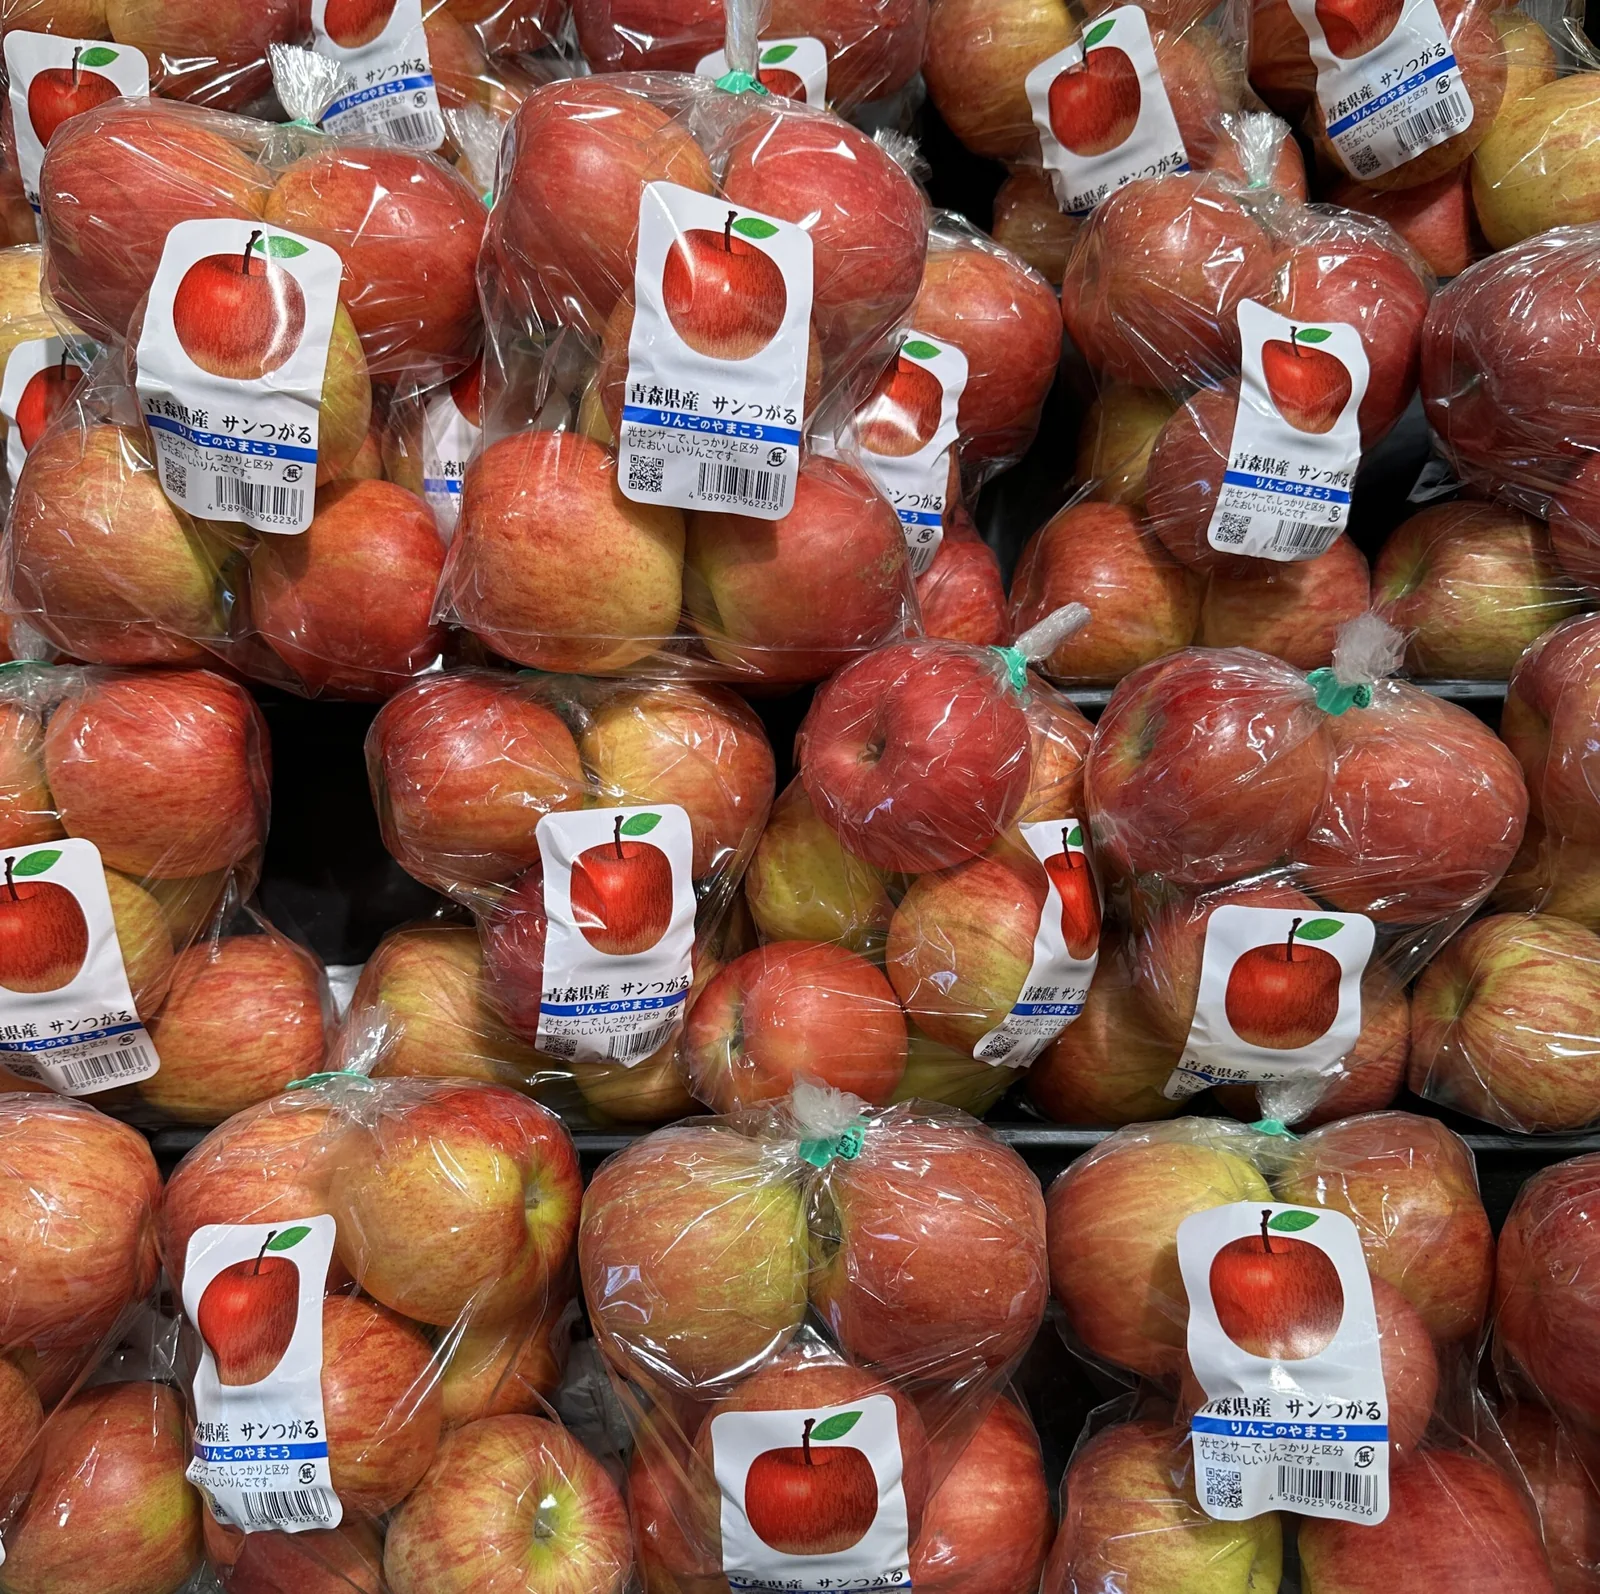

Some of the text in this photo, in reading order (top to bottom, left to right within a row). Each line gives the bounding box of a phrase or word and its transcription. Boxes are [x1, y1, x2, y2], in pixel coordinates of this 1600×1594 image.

[365, 58, 425, 84] サンつがる
[1327, 43, 1446, 123] 青森県産 サンつがる
[339, 81, 405, 110] りんごのやまこう
[1352, 74, 1427, 122] りんごのやまこう
[631, 383, 798, 425] 青森県産 サンつがる
[222, 415, 312, 444] サンつがる
[660, 412, 764, 439] りんごのやまこう
[179, 425, 278, 456] りんごのやまこう
[627, 426, 759, 455] 光センサーで、しっかりと区分
[628, 437, 737, 463] したおいしいりんごです。
[157, 433, 274, 471] 光センサーで、しっかりと区分
[161, 442, 252, 480] したおいしいりんごです。
[1233, 452, 1350, 487] 青森県産 サンつがる
[887, 488, 942, 510] ンつがる
[1255, 478, 1331, 499] りんごのやまこう
[701, 492, 738, 504] 589925
[742, 498, 779, 511] 962236
[1225, 498, 1308, 520] したおいしいりんごです。
[1226, 488, 1326, 512] 光センサーで、しっかりと区分
[221, 504, 255, 519] 589925
[260, 511, 298, 526] 962236
[547, 975, 689, 1002] 青森県産 サンつがる
[1022, 986, 1059, 1001] 青森県産
[576, 999, 664, 1015] りんごのやまこう
[1031, 1005, 1078, 1014] りんごのやまこう
[49, 1010, 133, 1034] サンつがる
[545, 1012, 660, 1027] 光センサーで、しっかりと区分
[545, 1023, 642, 1036] したおいしいりんごです。
[9, 1030, 107, 1050] りんごのやまこう
[114, 1066, 149, 1079] 962236
[1285, 1399, 1382, 1421] サンつがる
[241, 1420, 319, 1441] サンつがる
[1231, 1422, 1348, 1439] りんごのやまこう
[204, 1446, 290, 1460] りんごのやまこう
[1200, 1437, 1344, 1457] 光センサーで、しっかりと区分
[1202, 1449, 1321, 1466] したおいしいりんごです。
[1282, 1494, 1324, 1507] 589925
[1329, 1501, 1373, 1516] 962236
[816, 1568, 903, 1589] サンつがる
